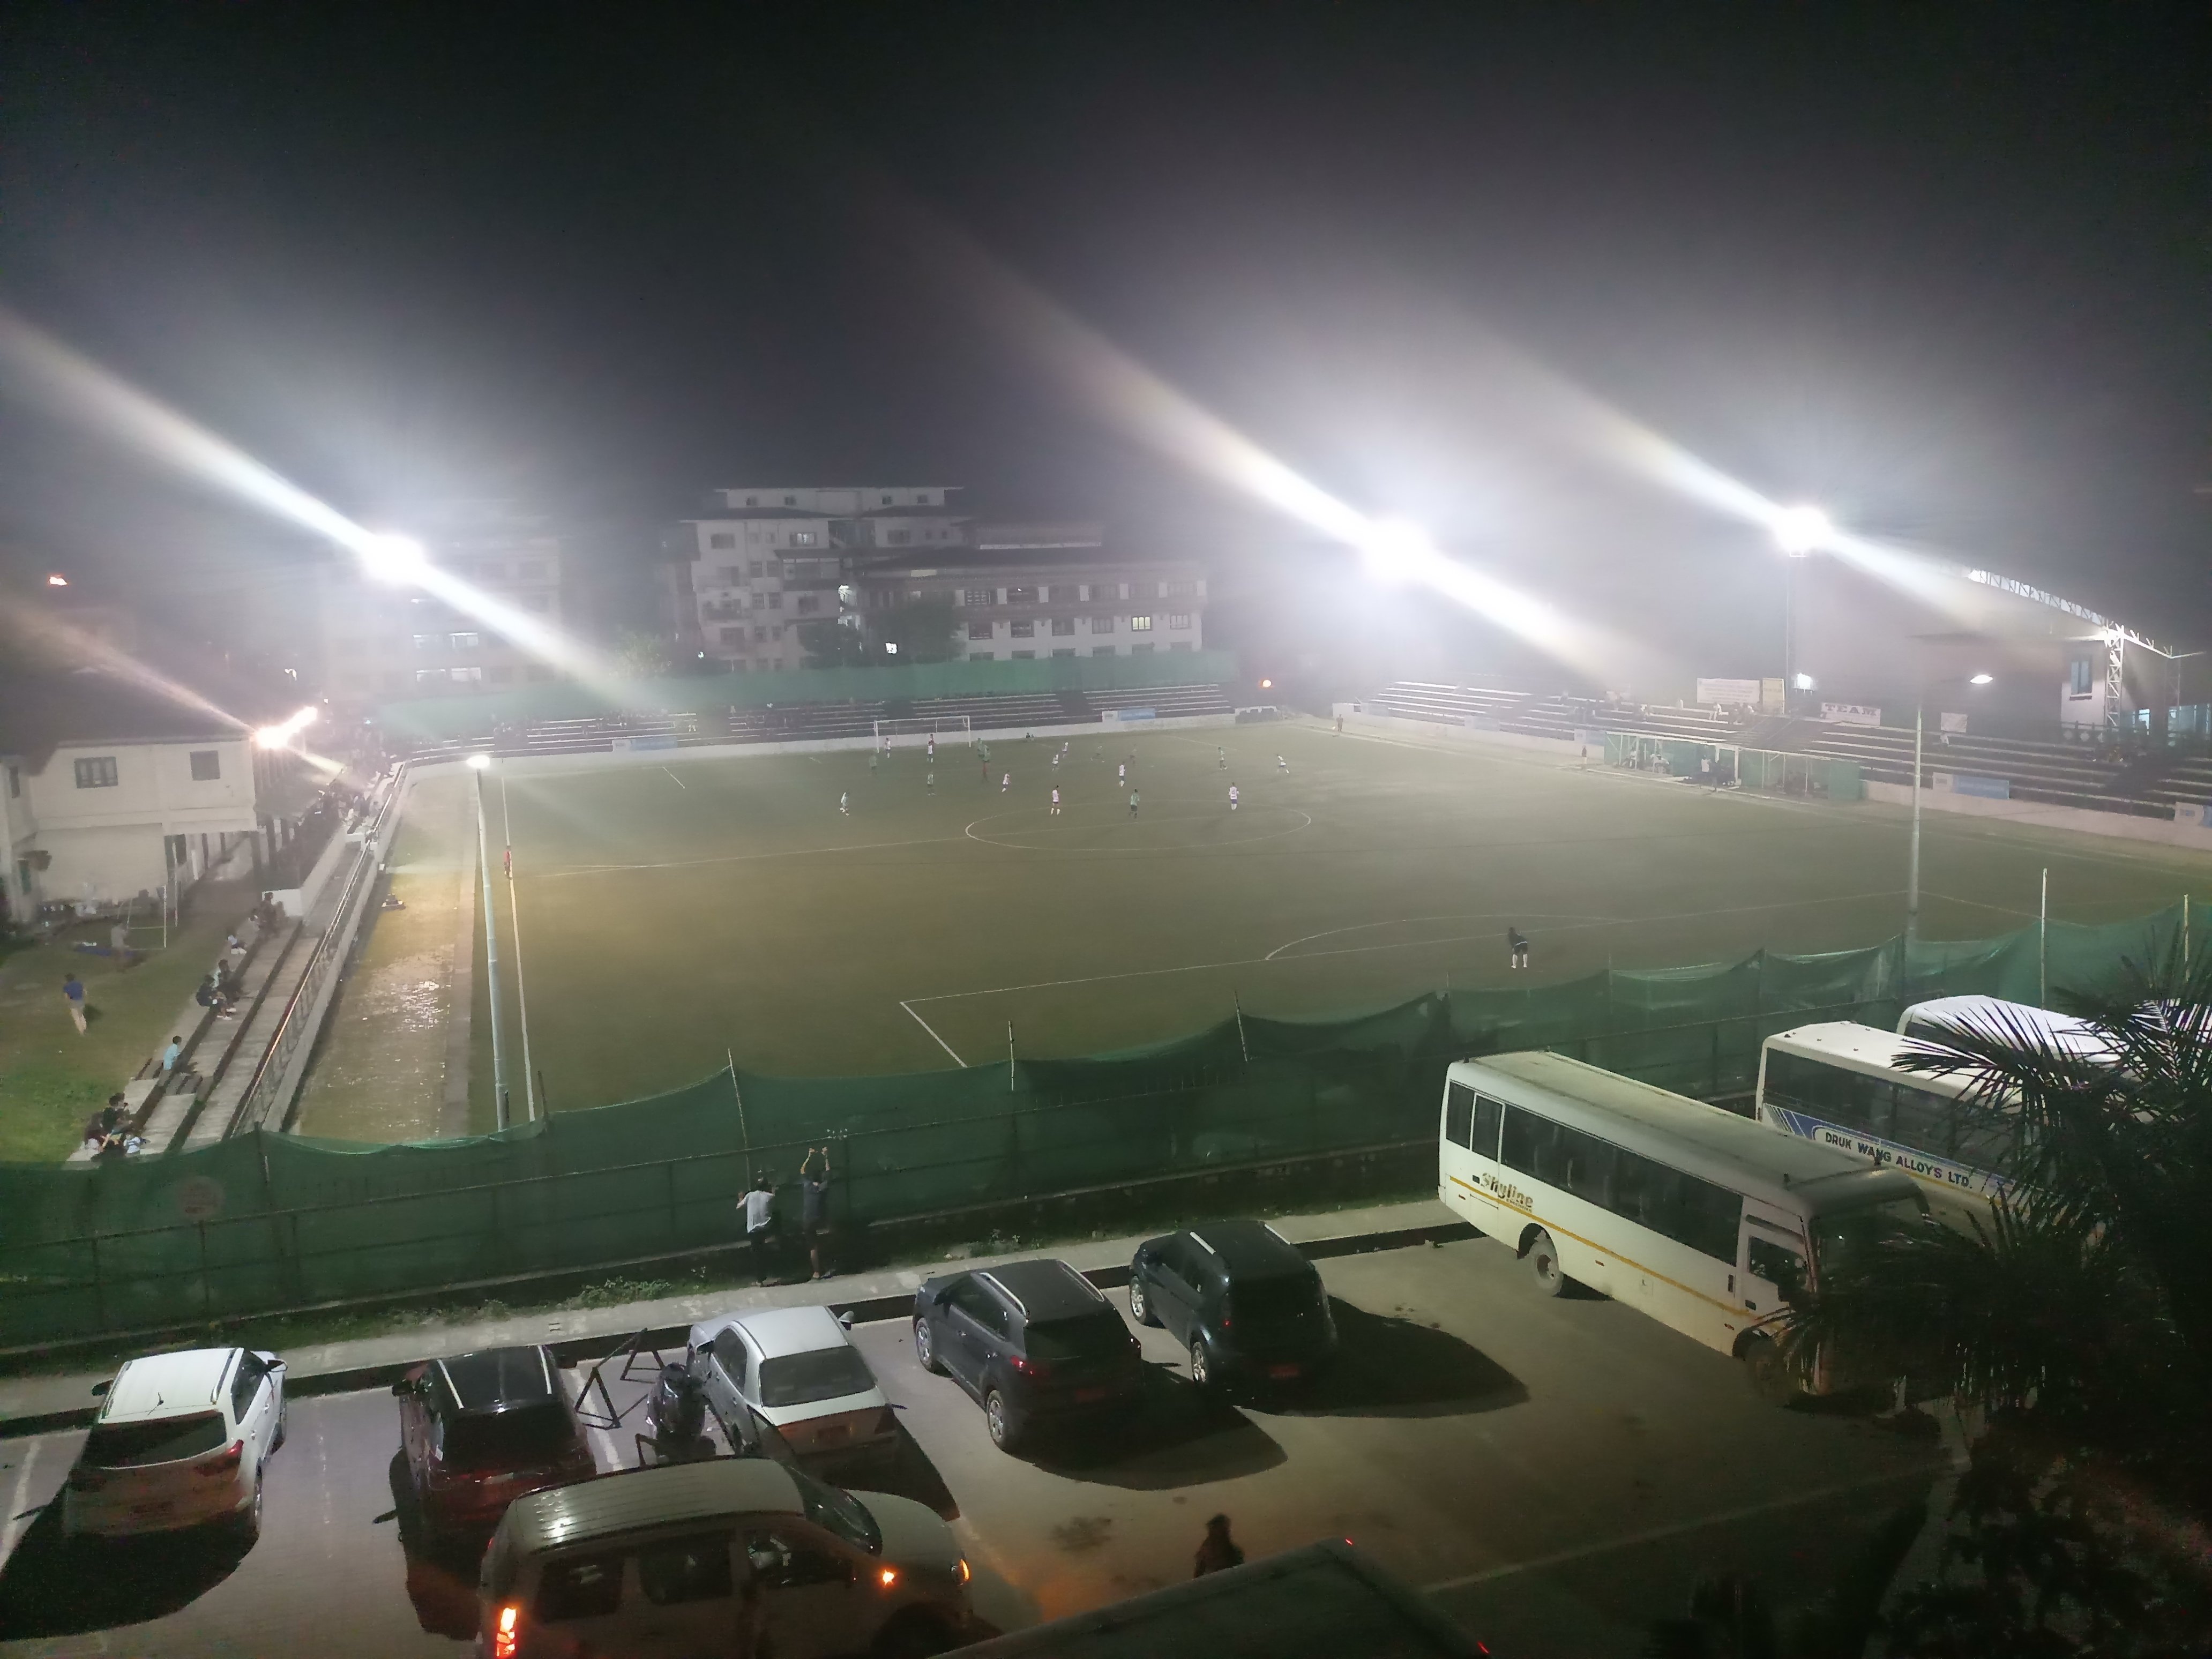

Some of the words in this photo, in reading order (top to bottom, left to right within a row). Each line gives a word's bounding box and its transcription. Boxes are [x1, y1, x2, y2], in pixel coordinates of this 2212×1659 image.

[1825, 1132, 1851, 1150] DRUK
[1857, 1142, 1892, 1162] WANG
[1896, 1155, 1942, 1179] ALLOYS
[1948, 1171, 1972, 1190] LTD.
[1480, 1172, 1533, 1208] Skyline
